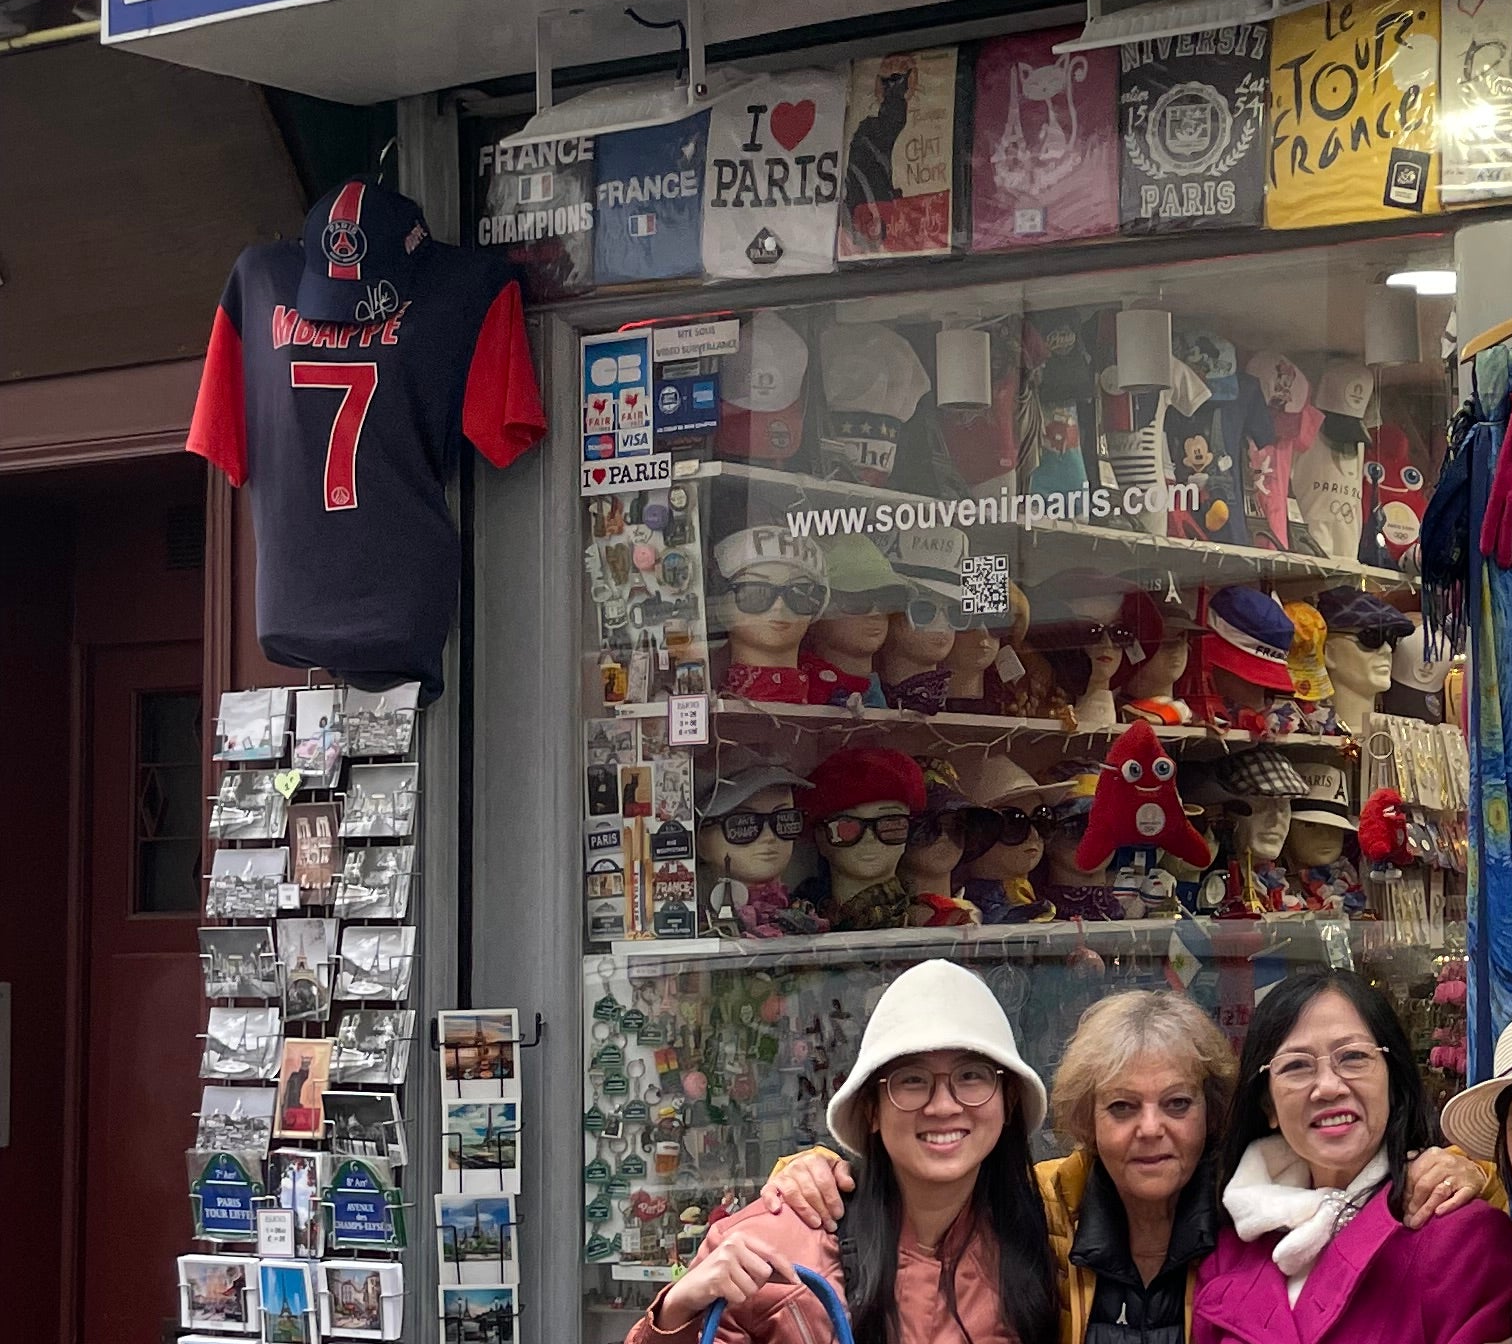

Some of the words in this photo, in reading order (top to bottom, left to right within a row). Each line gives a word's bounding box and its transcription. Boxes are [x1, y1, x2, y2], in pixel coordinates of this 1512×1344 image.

[742, 104, 768, 153] I
[478, 135, 595, 177] FRANCE
[595, 169, 698, 209] FRANCE
[710, 150, 839, 208] PARIS
[1140, 179, 1237, 219] PARIS
[478, 201, 594, 246] CHAMPIONS
[587, 415, 611, 427] FAIR
[620, 410, 644, 422] FAIR
[290, 360, 378, 512] 7
[622, 432, 649, 448] VISA
[582, 468, 592, 488] I
[608, 459, 670, 485] PARIS
[1313, 481, 1348, 496] PARIS
[787, 481, 1200, 538] www.souvenirparis.com
[911, 535, 955, 553] PARIS
[590, 833, 618, 848] PARIS
[205, 1207, 228, 1220] TOUR
[216, 1196, 242, 1208] PARIS
[346, 1202, 376, 1214] AVENUE
